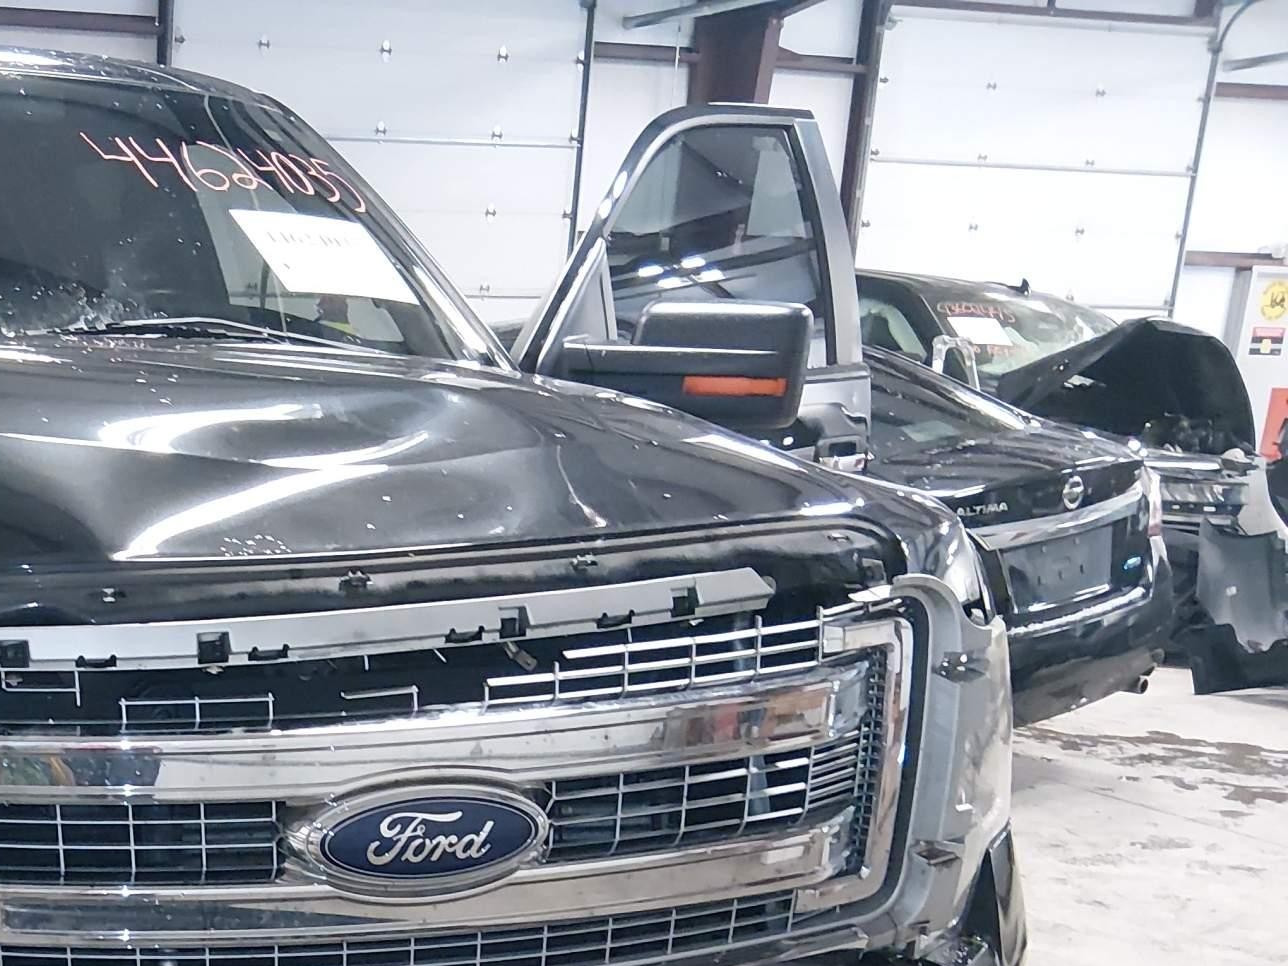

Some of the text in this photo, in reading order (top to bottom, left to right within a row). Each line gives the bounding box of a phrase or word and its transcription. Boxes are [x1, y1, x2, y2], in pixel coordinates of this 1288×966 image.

[79, 131, 367, 213] 44624035
[956, 501, 1009, 517] ALTIMA
[366, 810, 495, 866] Ford
